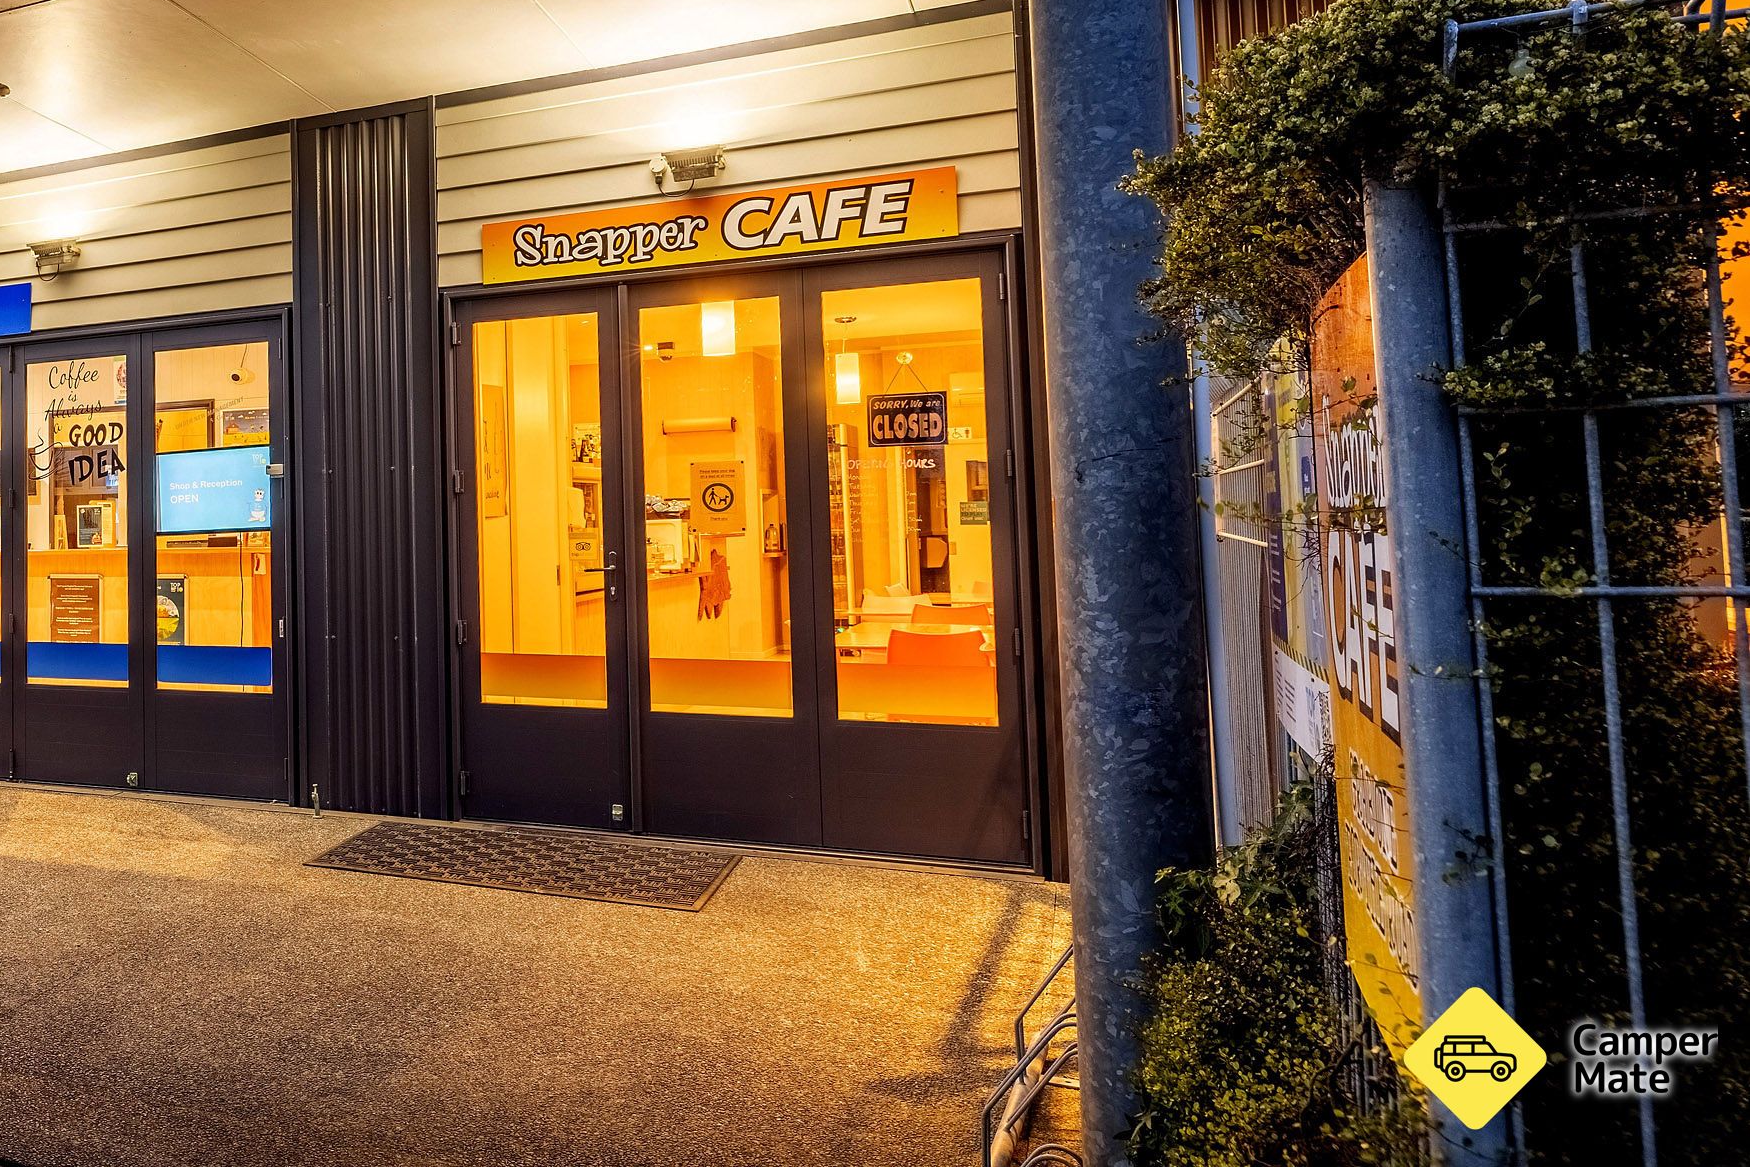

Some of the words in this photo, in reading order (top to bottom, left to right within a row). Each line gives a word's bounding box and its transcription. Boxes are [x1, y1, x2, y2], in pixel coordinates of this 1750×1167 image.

[514, 214, 708, 267] Snapper
[721, 179, 914, 251] CAFE
[49, 361, 99, 389] Coffee
[68, 391, 78, 402] is
[873, 400, 909, 410] SORRY,
[910, 400, 923, 408] We
[45, 398, 102, 422] Always
[69, 422, 123, 446] GOOD
[873, 412, 942, 440] CLOSED
[68, 448, 125, 485] IDEA
[170, 481, 190, 491] Shop
[200, 478, 243, 488] Reception
[170, 494, 199, 504] OPEN
[1328, 530, 1400, 735] CAFE
